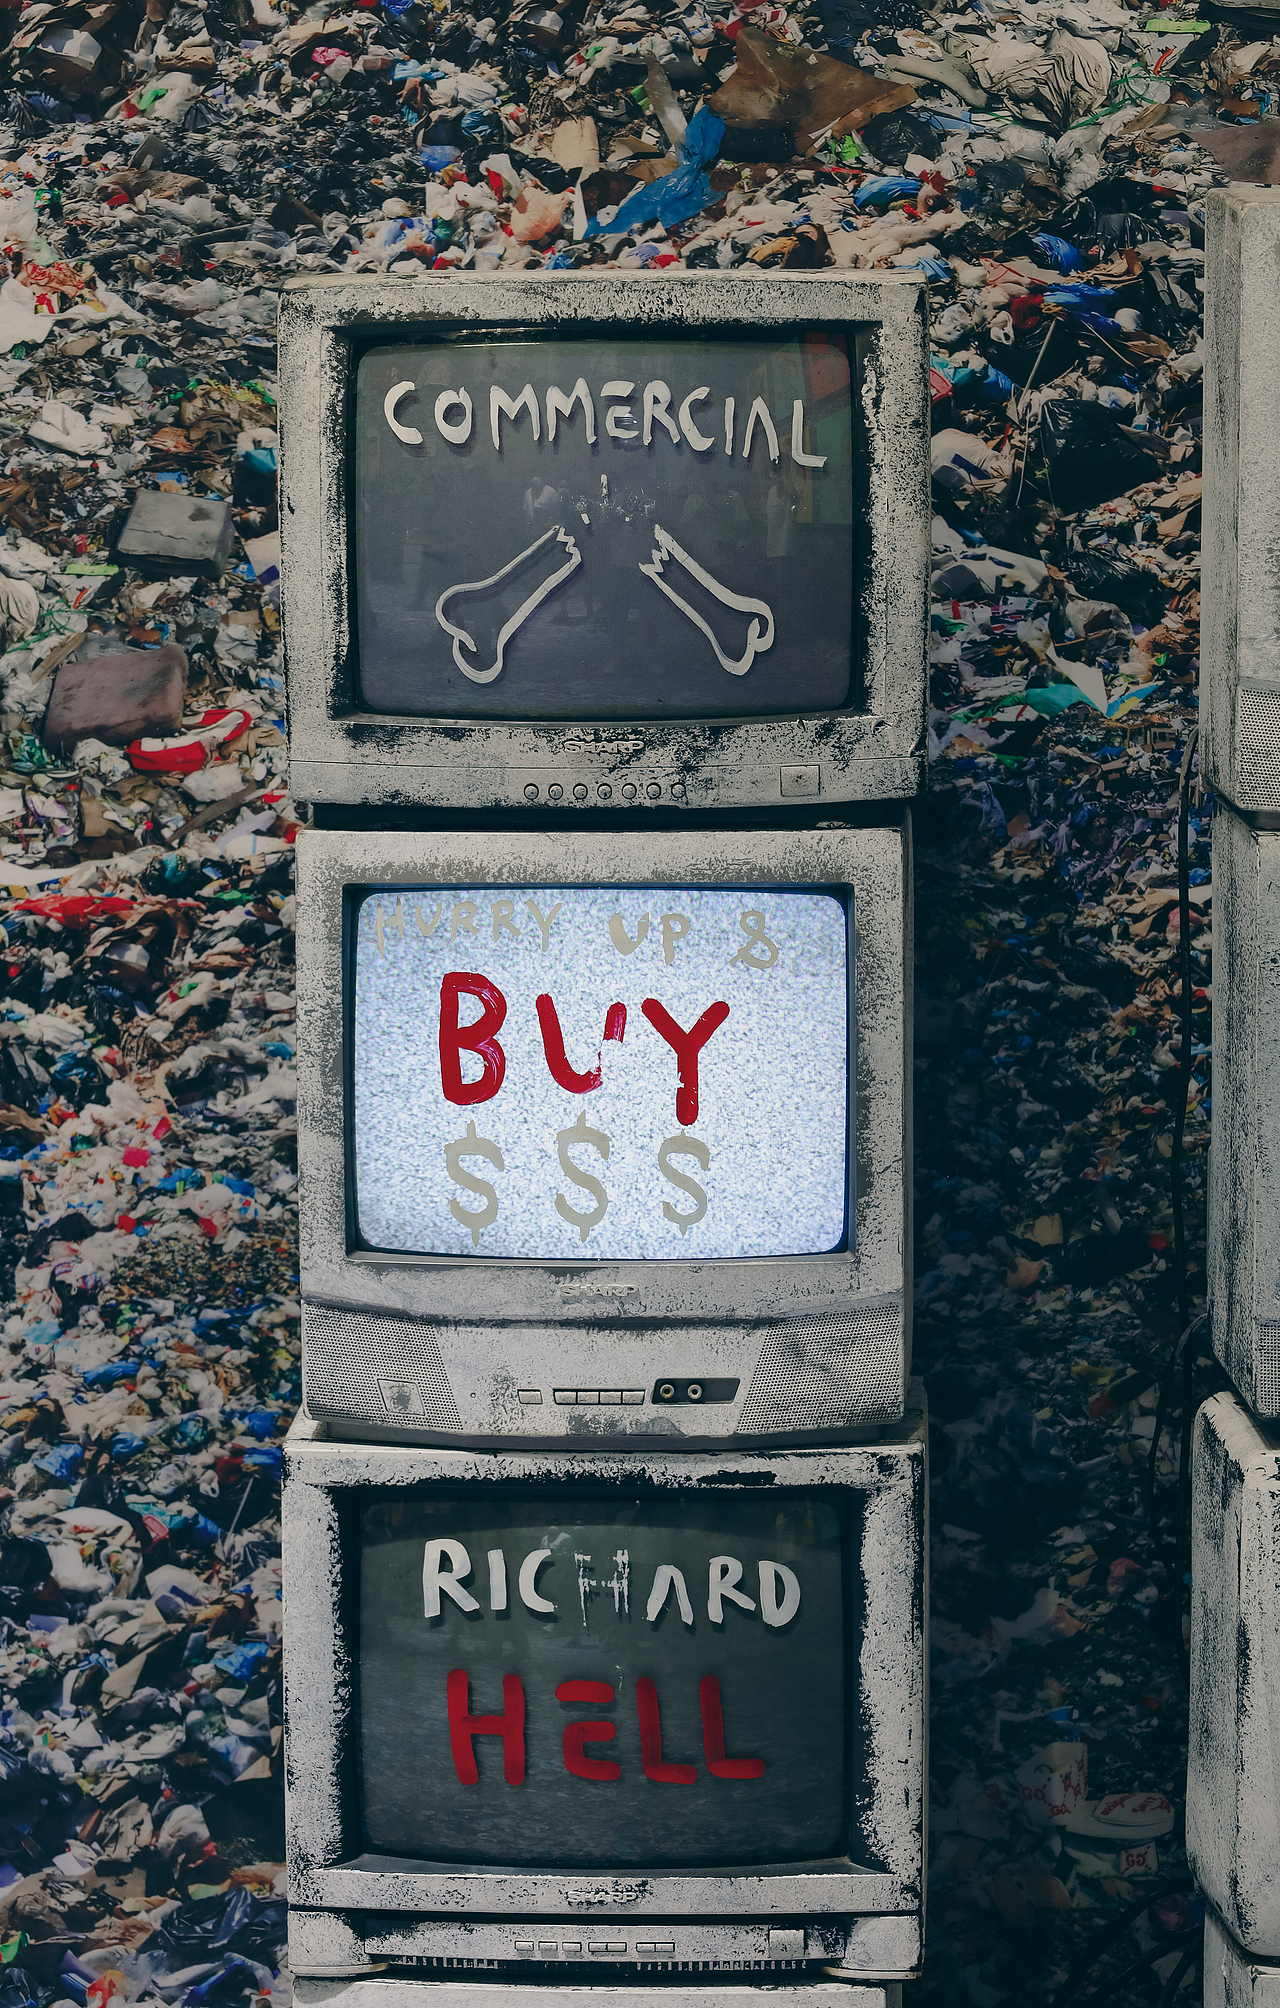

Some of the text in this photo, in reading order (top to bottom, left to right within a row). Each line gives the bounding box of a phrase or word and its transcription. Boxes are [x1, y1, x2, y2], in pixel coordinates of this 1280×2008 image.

[384, 377, 827, 468] COMMERCIAL
[564, 740, 644, 753] SHARP
[376, 897, 562, 956] HURRY
[609, 911, 691, 965] UP
[440, 972, 730, 1125] BUY
[560, 1284, 639, 1297] SHARP
[447, 1669, 766, 1785] HELL
[567, 1891, 637, 1903] SHARP
